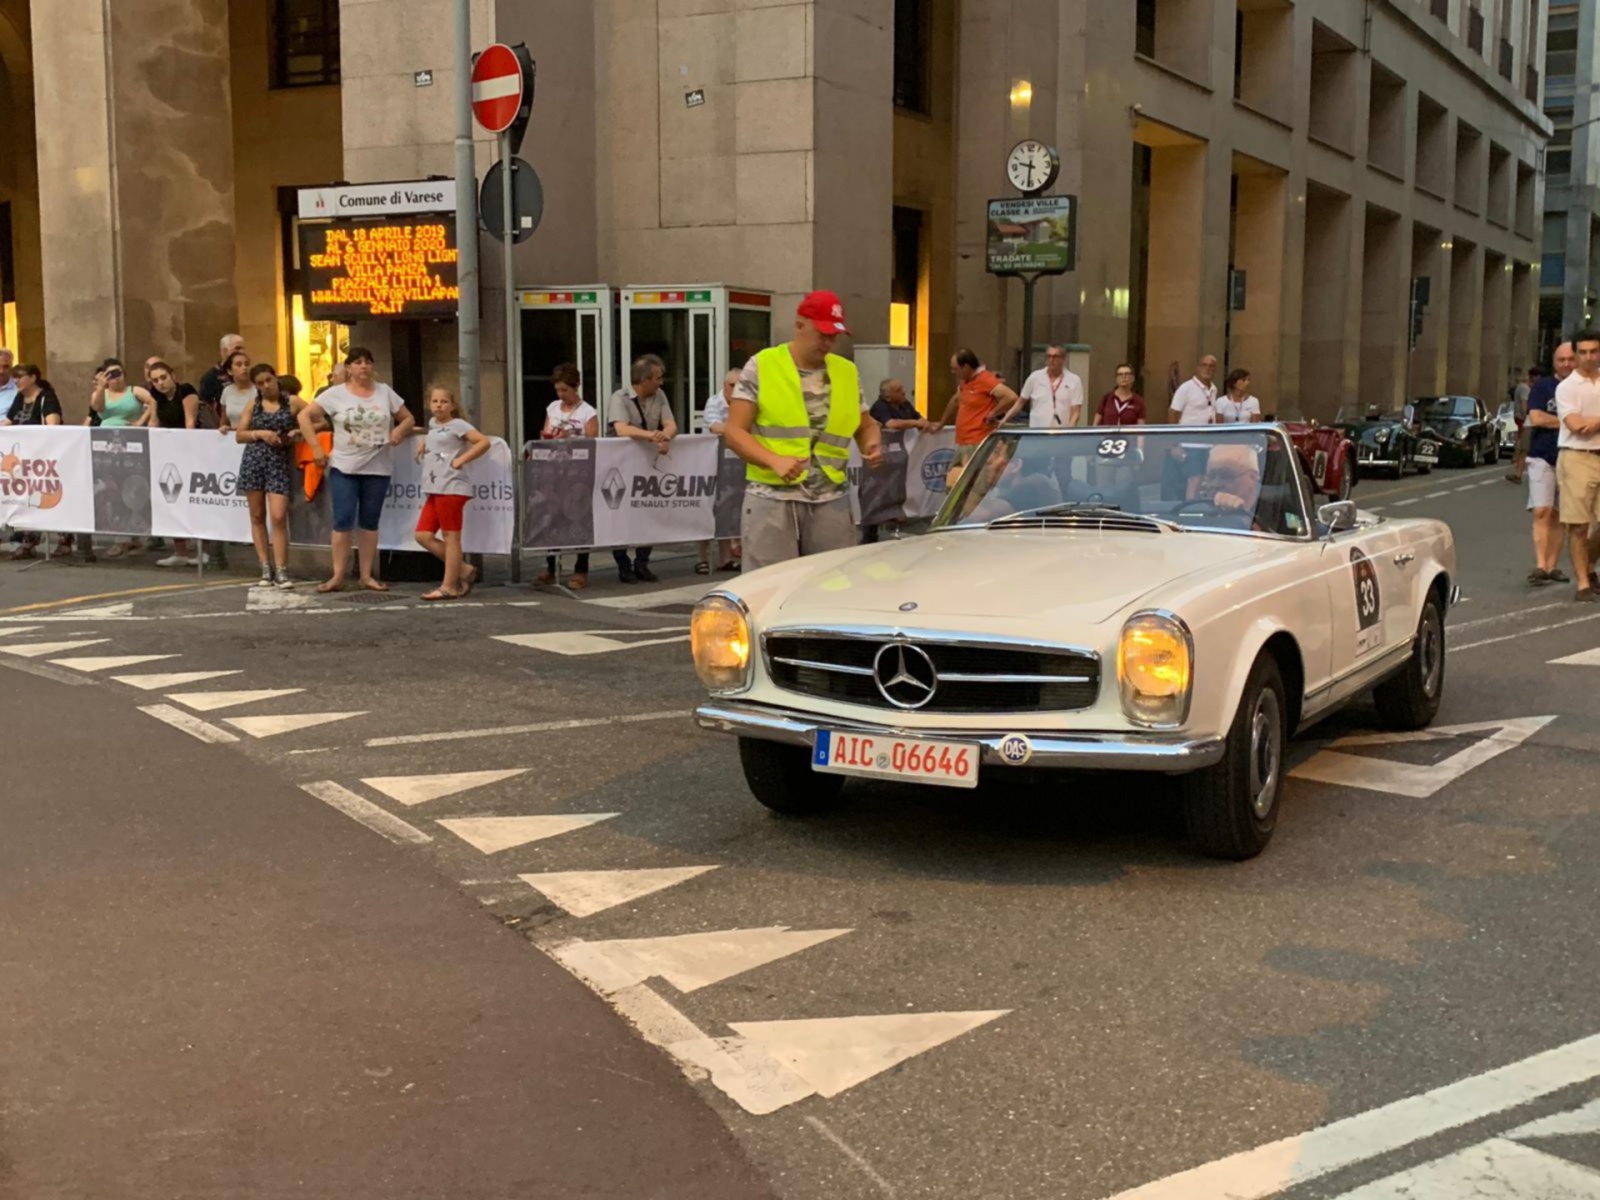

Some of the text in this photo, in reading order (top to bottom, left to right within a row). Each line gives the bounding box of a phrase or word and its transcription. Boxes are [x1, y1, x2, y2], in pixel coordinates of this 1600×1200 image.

[339, 190, 444, 208] Comune di Varese
[325, 224, 445, 242] DAL 18 APRILE 2019
[326, 238, 446, 254] AL 6 GENNAIO 2020
[310, 254, 340, 267] SEAN
[394, 250, 425, 263] LONG
[991, 254, 1032, 263] TRADATE
[346, 264, 427, 277] VILLA PANZA
[332, 275, 441, 290] PIAZZALE LITTA 1
[1098, 439, 1128, 455] 33
[1421, 445, 1434, 455] 22
[21, 459, 60, 478] FOX
[0, 478, 60, 496] TOWN
[189, 471, 247, 497] PAGL
[631, 473, 719, 498] PAGLIN
[189, 496, 250, 508] RENAULT STO
[630, 500, 701, 508] RENAULT STORE
[1360, 578, 1376, 617] 33
[834, 736, 873, 767] AIC
[892, 742, 969, 777] 06646
